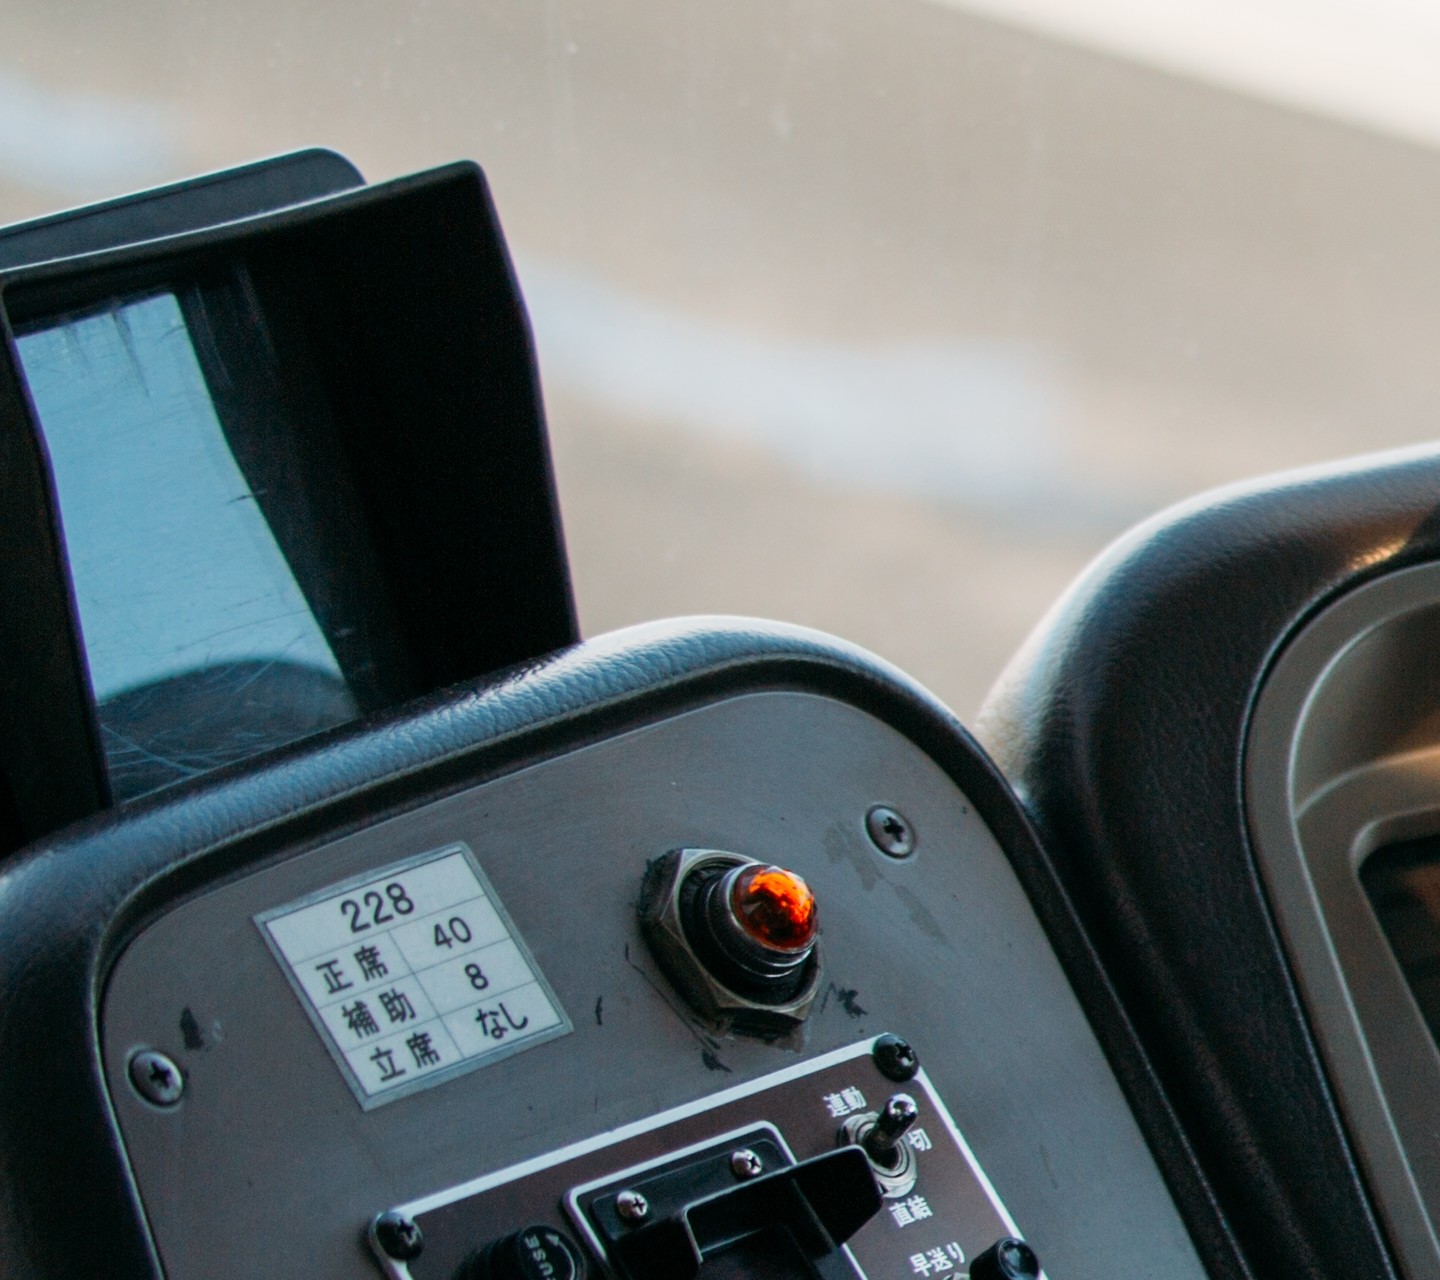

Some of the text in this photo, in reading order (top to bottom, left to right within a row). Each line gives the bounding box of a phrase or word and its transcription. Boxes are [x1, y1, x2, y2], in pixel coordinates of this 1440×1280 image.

[340, 882, 415, 934] 228
[433, 916, 472, 949] 40
[315, 945, 390, 995] 正席
[464, 963, 489, 991] 8
[341, 988, 417, 1039] 補助
[475, 1002, 529, 1040] なし
[369, 1031, 441, 1083] 立席
[823, 1086, 868, 1118] 連動
[908, 1128, 932, 1152] 切
[888, 1195, 933, 1227] 直結
[908, 1241, 966, 1277] 早送り
